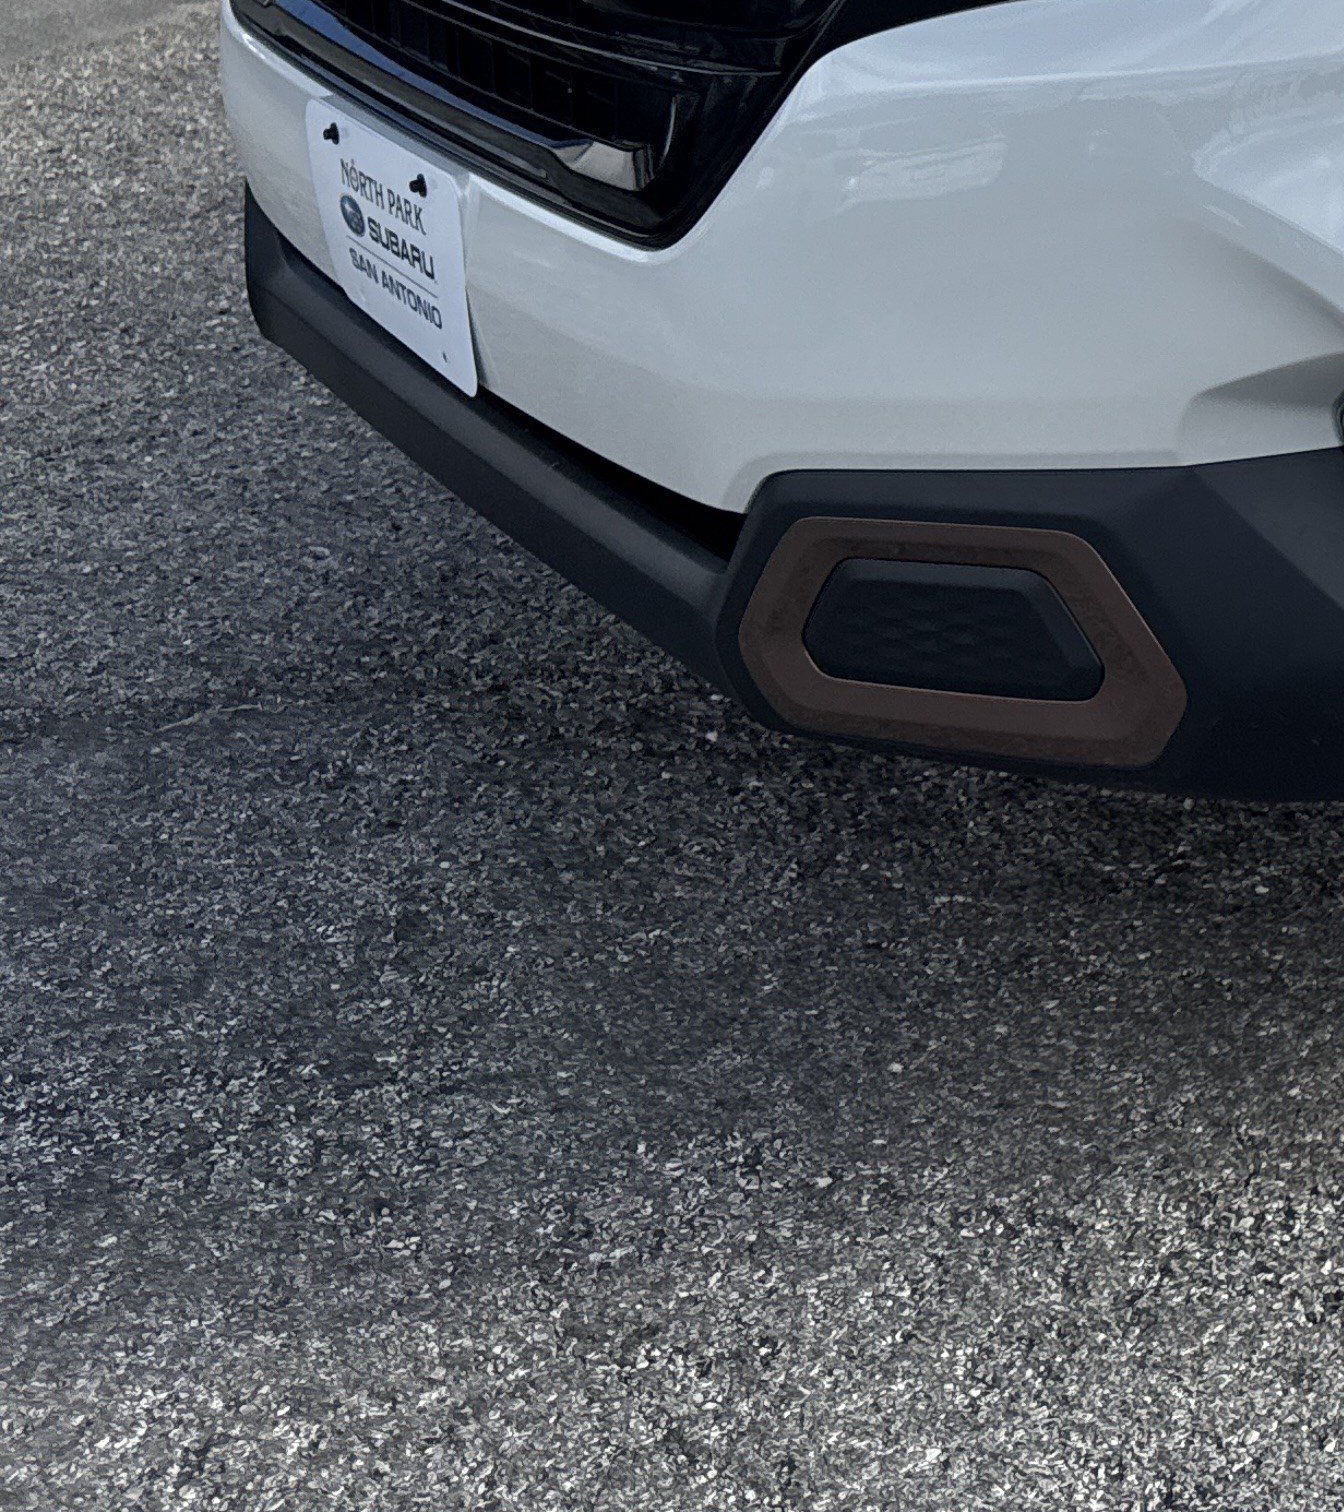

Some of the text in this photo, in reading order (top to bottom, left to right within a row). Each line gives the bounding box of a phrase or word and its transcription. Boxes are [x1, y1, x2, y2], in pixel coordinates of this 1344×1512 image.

[340, 158, 427, 236] NORTH PARK
[367, 216, 436, 281] SUBARU
[349, 247, 443, 330] SAN ANTONIO
